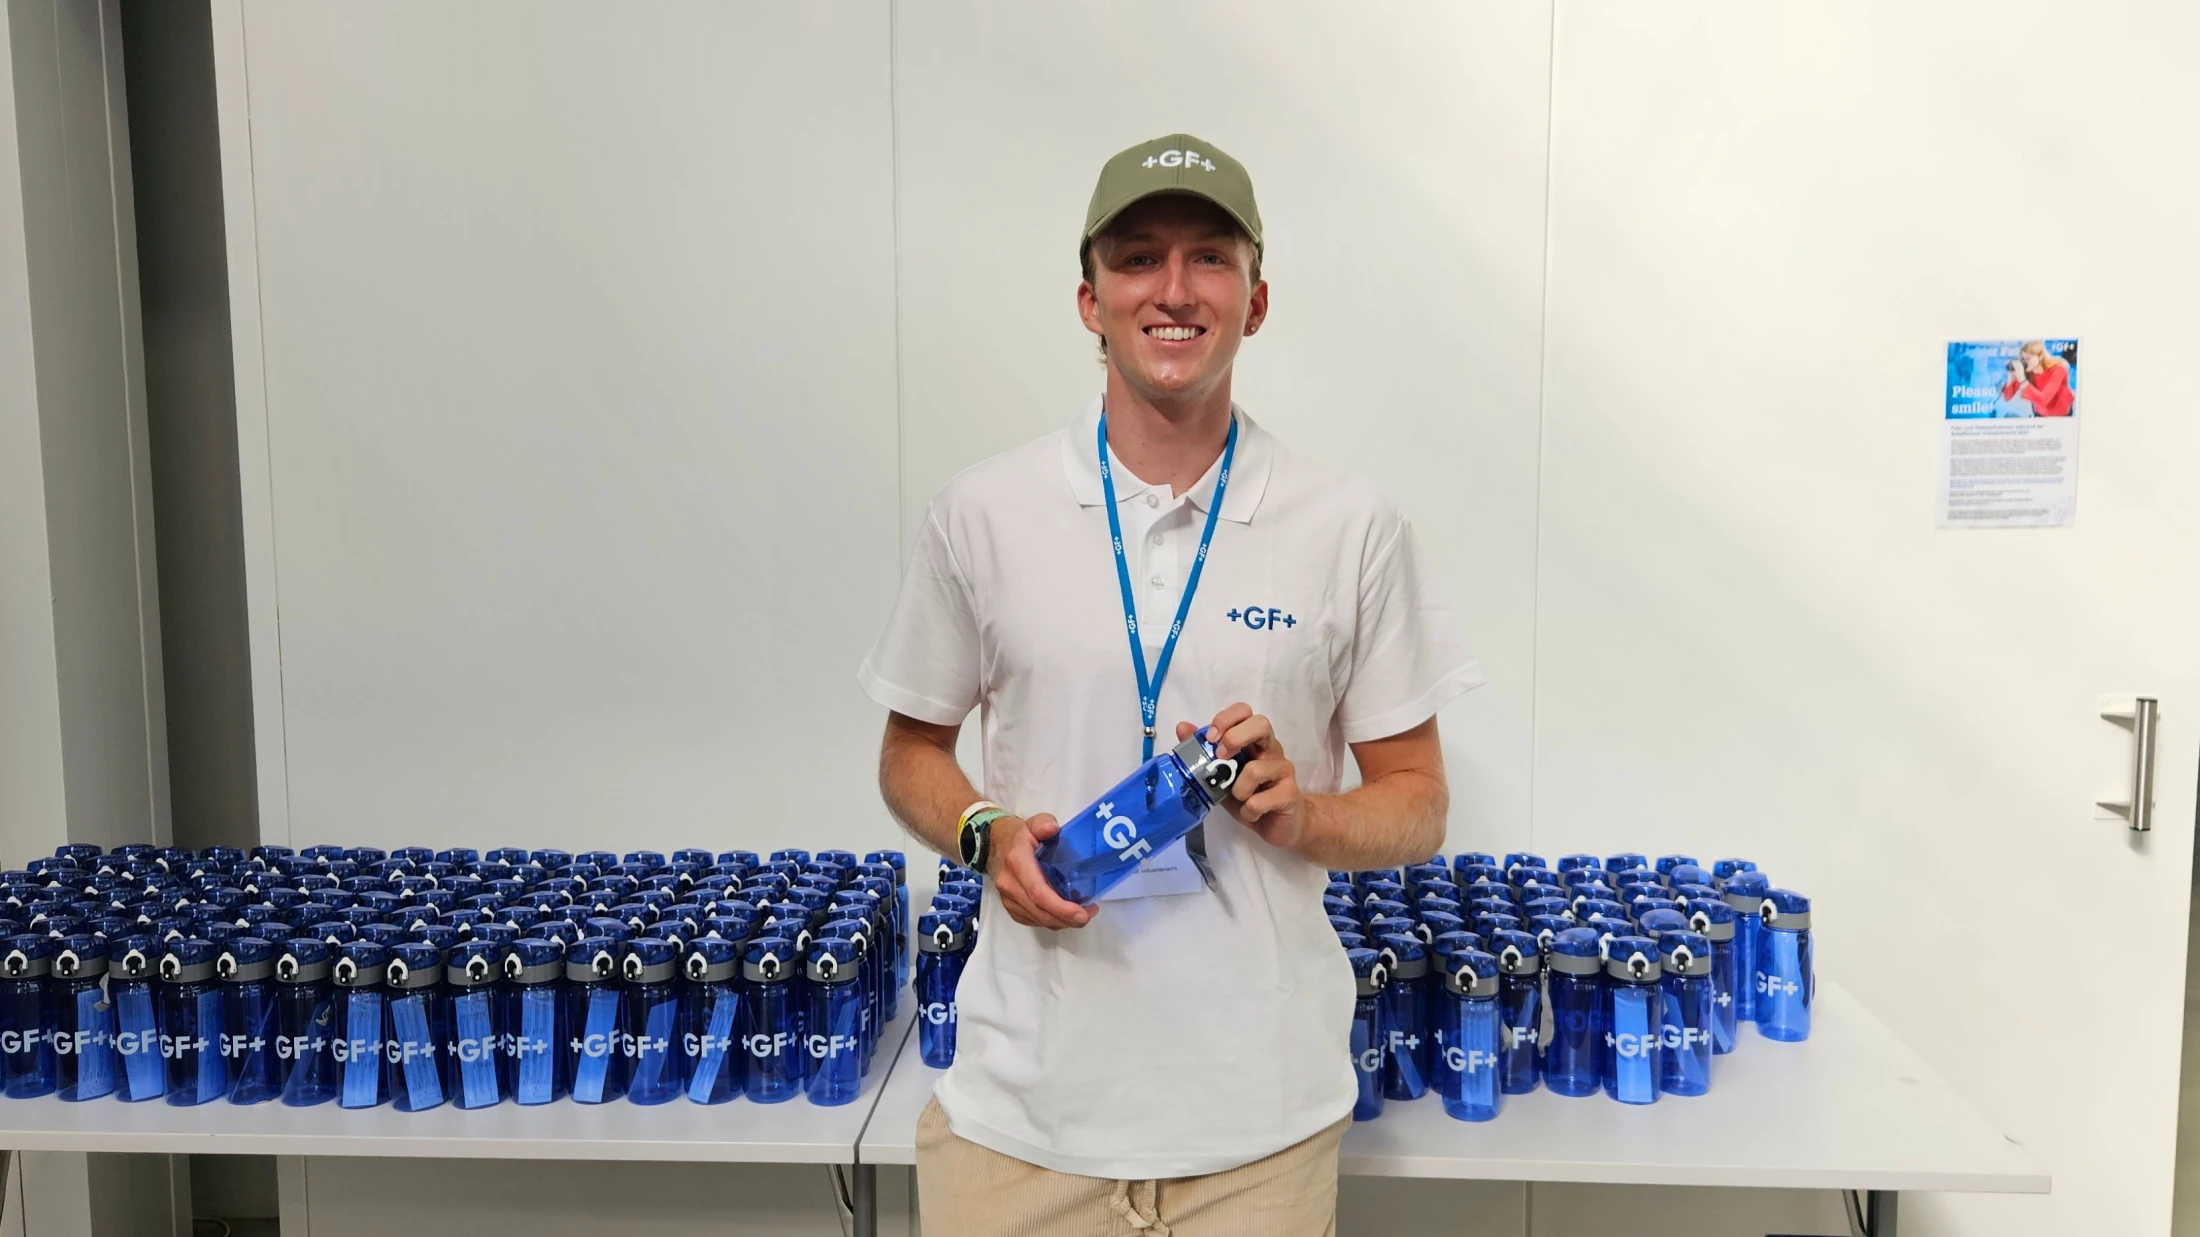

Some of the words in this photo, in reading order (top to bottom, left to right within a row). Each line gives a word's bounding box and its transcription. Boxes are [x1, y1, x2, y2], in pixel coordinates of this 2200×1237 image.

[1952, 385, 1996, 398] Please
[1951, 400, 1994, 415] smile!
[1226, 606, 1296, 630] +GF+
[0, 1028, 52, 1054] GF+
